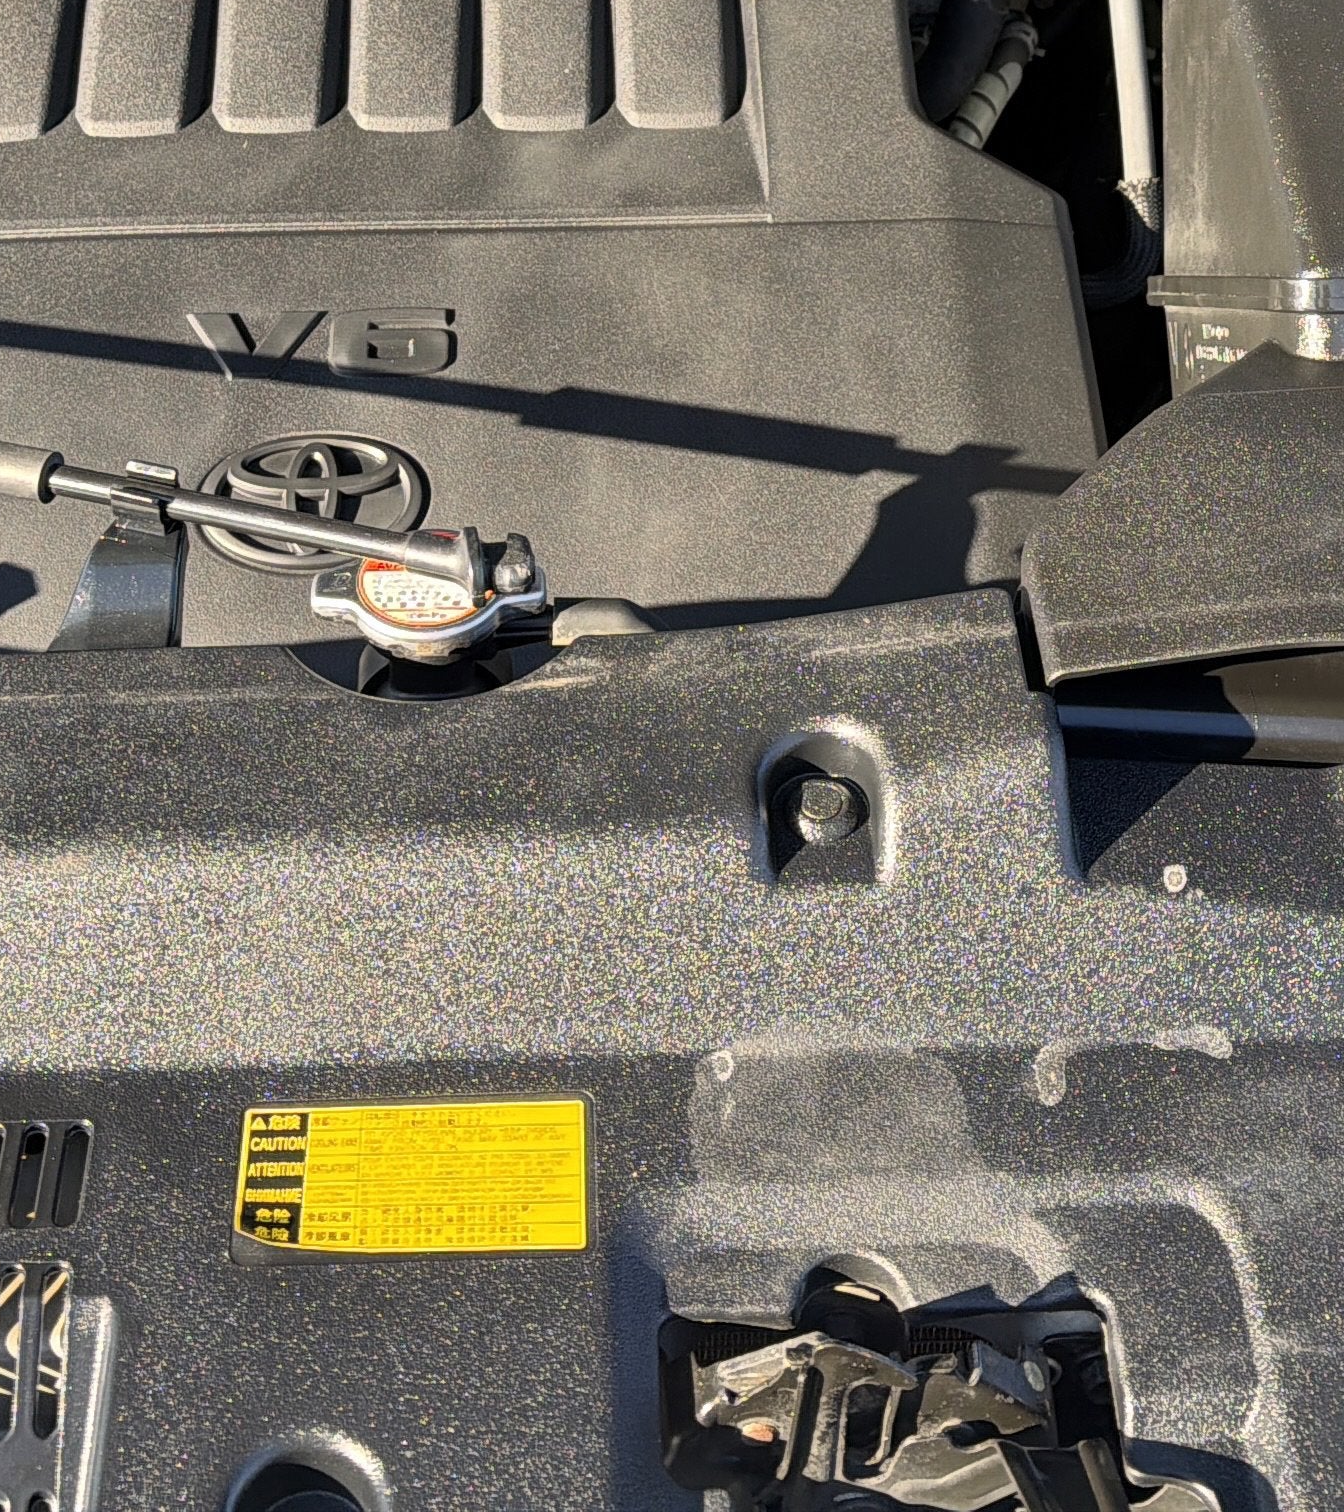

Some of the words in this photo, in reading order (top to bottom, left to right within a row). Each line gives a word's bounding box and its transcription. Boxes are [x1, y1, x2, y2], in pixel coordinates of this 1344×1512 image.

[186, 307, 458, 381] V6
[250, 1136, 306, 1151] CAUTION
[247, 1162, 305, 1177] ATTENTION
